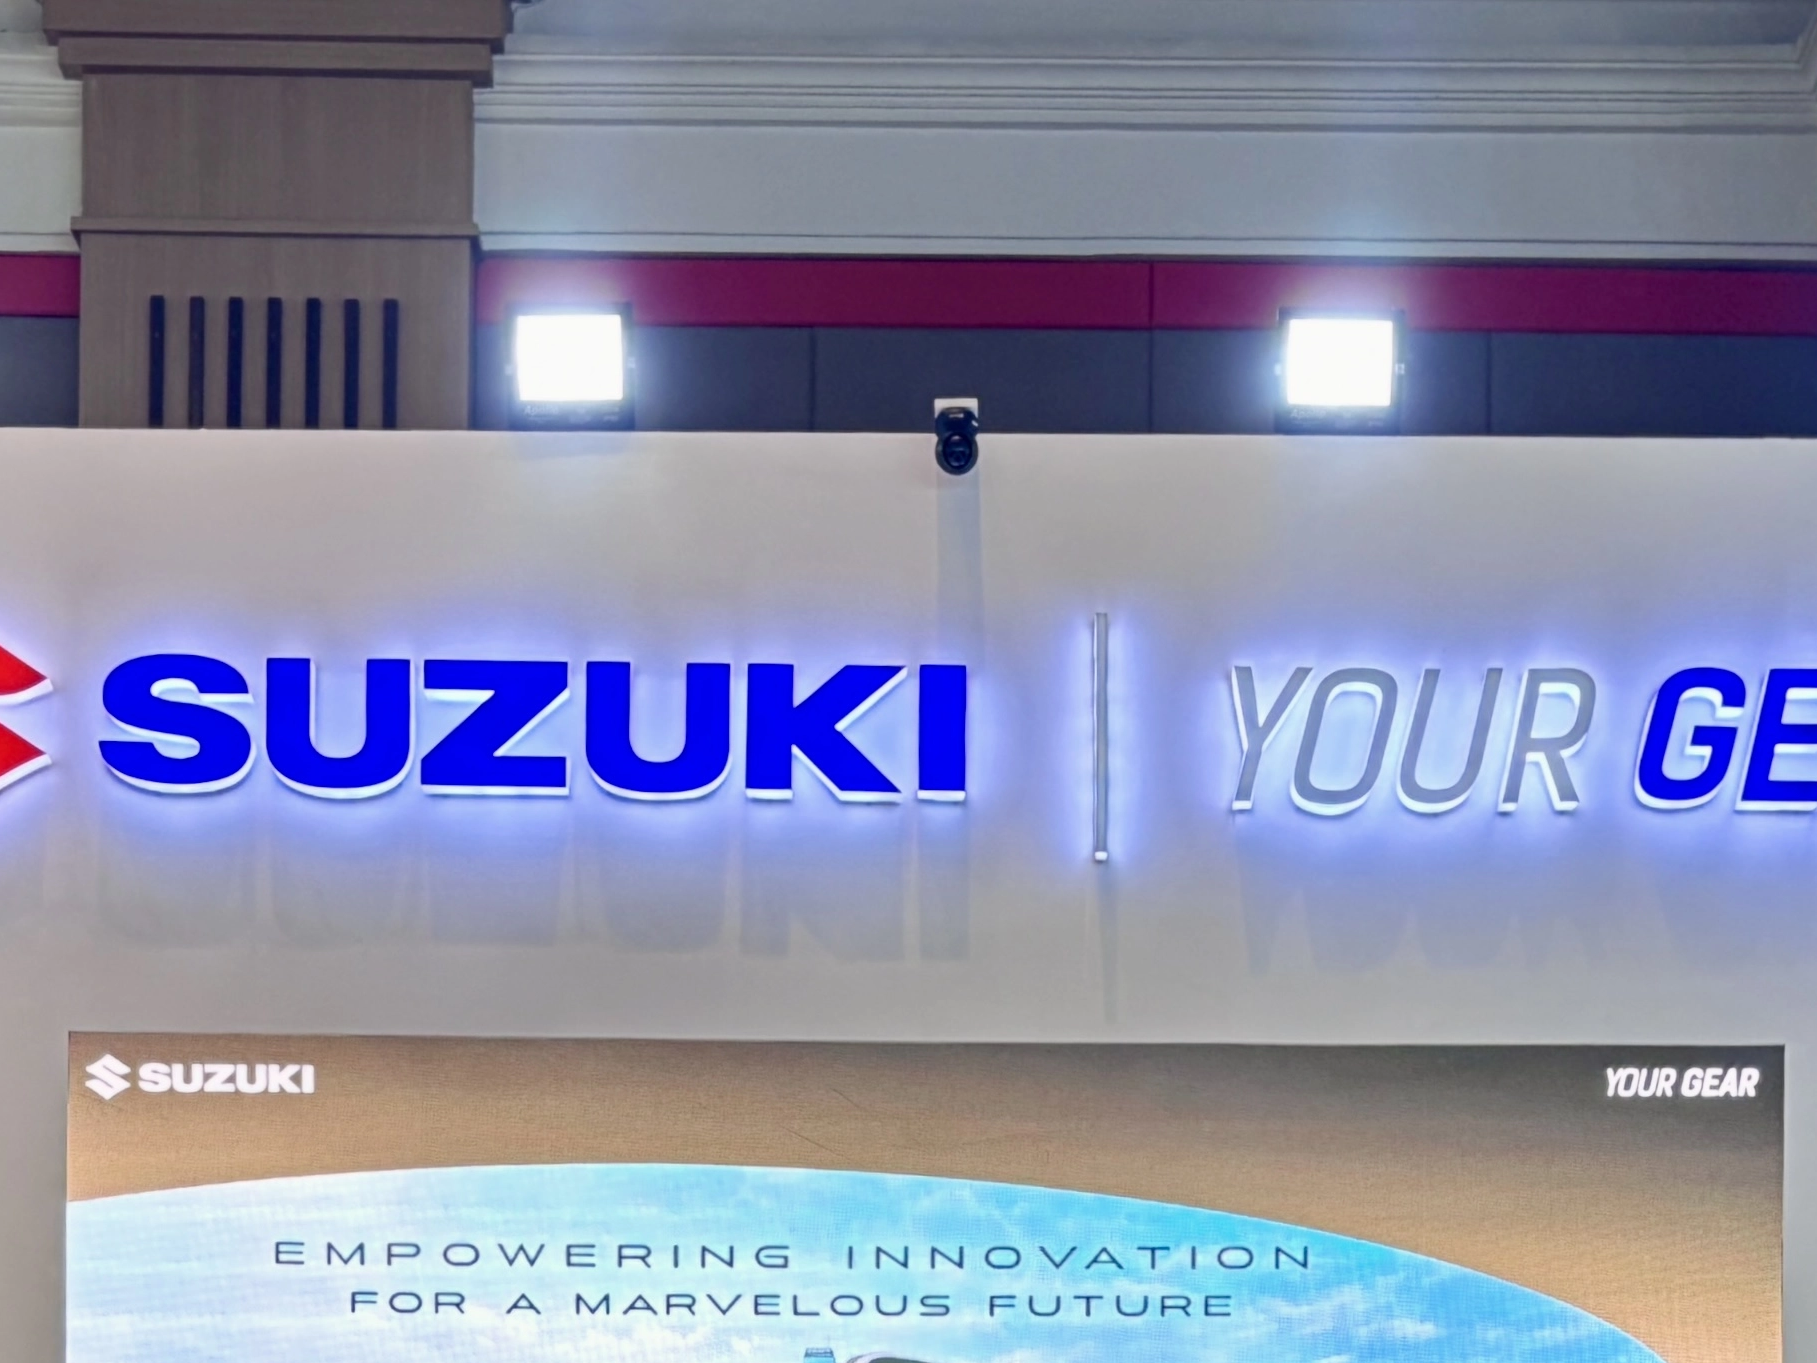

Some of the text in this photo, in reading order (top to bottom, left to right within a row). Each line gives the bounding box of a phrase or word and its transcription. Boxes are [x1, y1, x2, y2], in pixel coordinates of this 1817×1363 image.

[99, 652, 969, 804] SUZUKI
[1230, 664, 1597, 816] YOUR
[138, 1063, 315, 1094] SUZUKI
[1605, 1066, 1760, 1098] YOUR GEAR
[274, 1241, 1312, 1270] EMPOWERING INNOVATION
[349, 1291, 1232, 1318] FOR A MARVELOUS FUTURE
